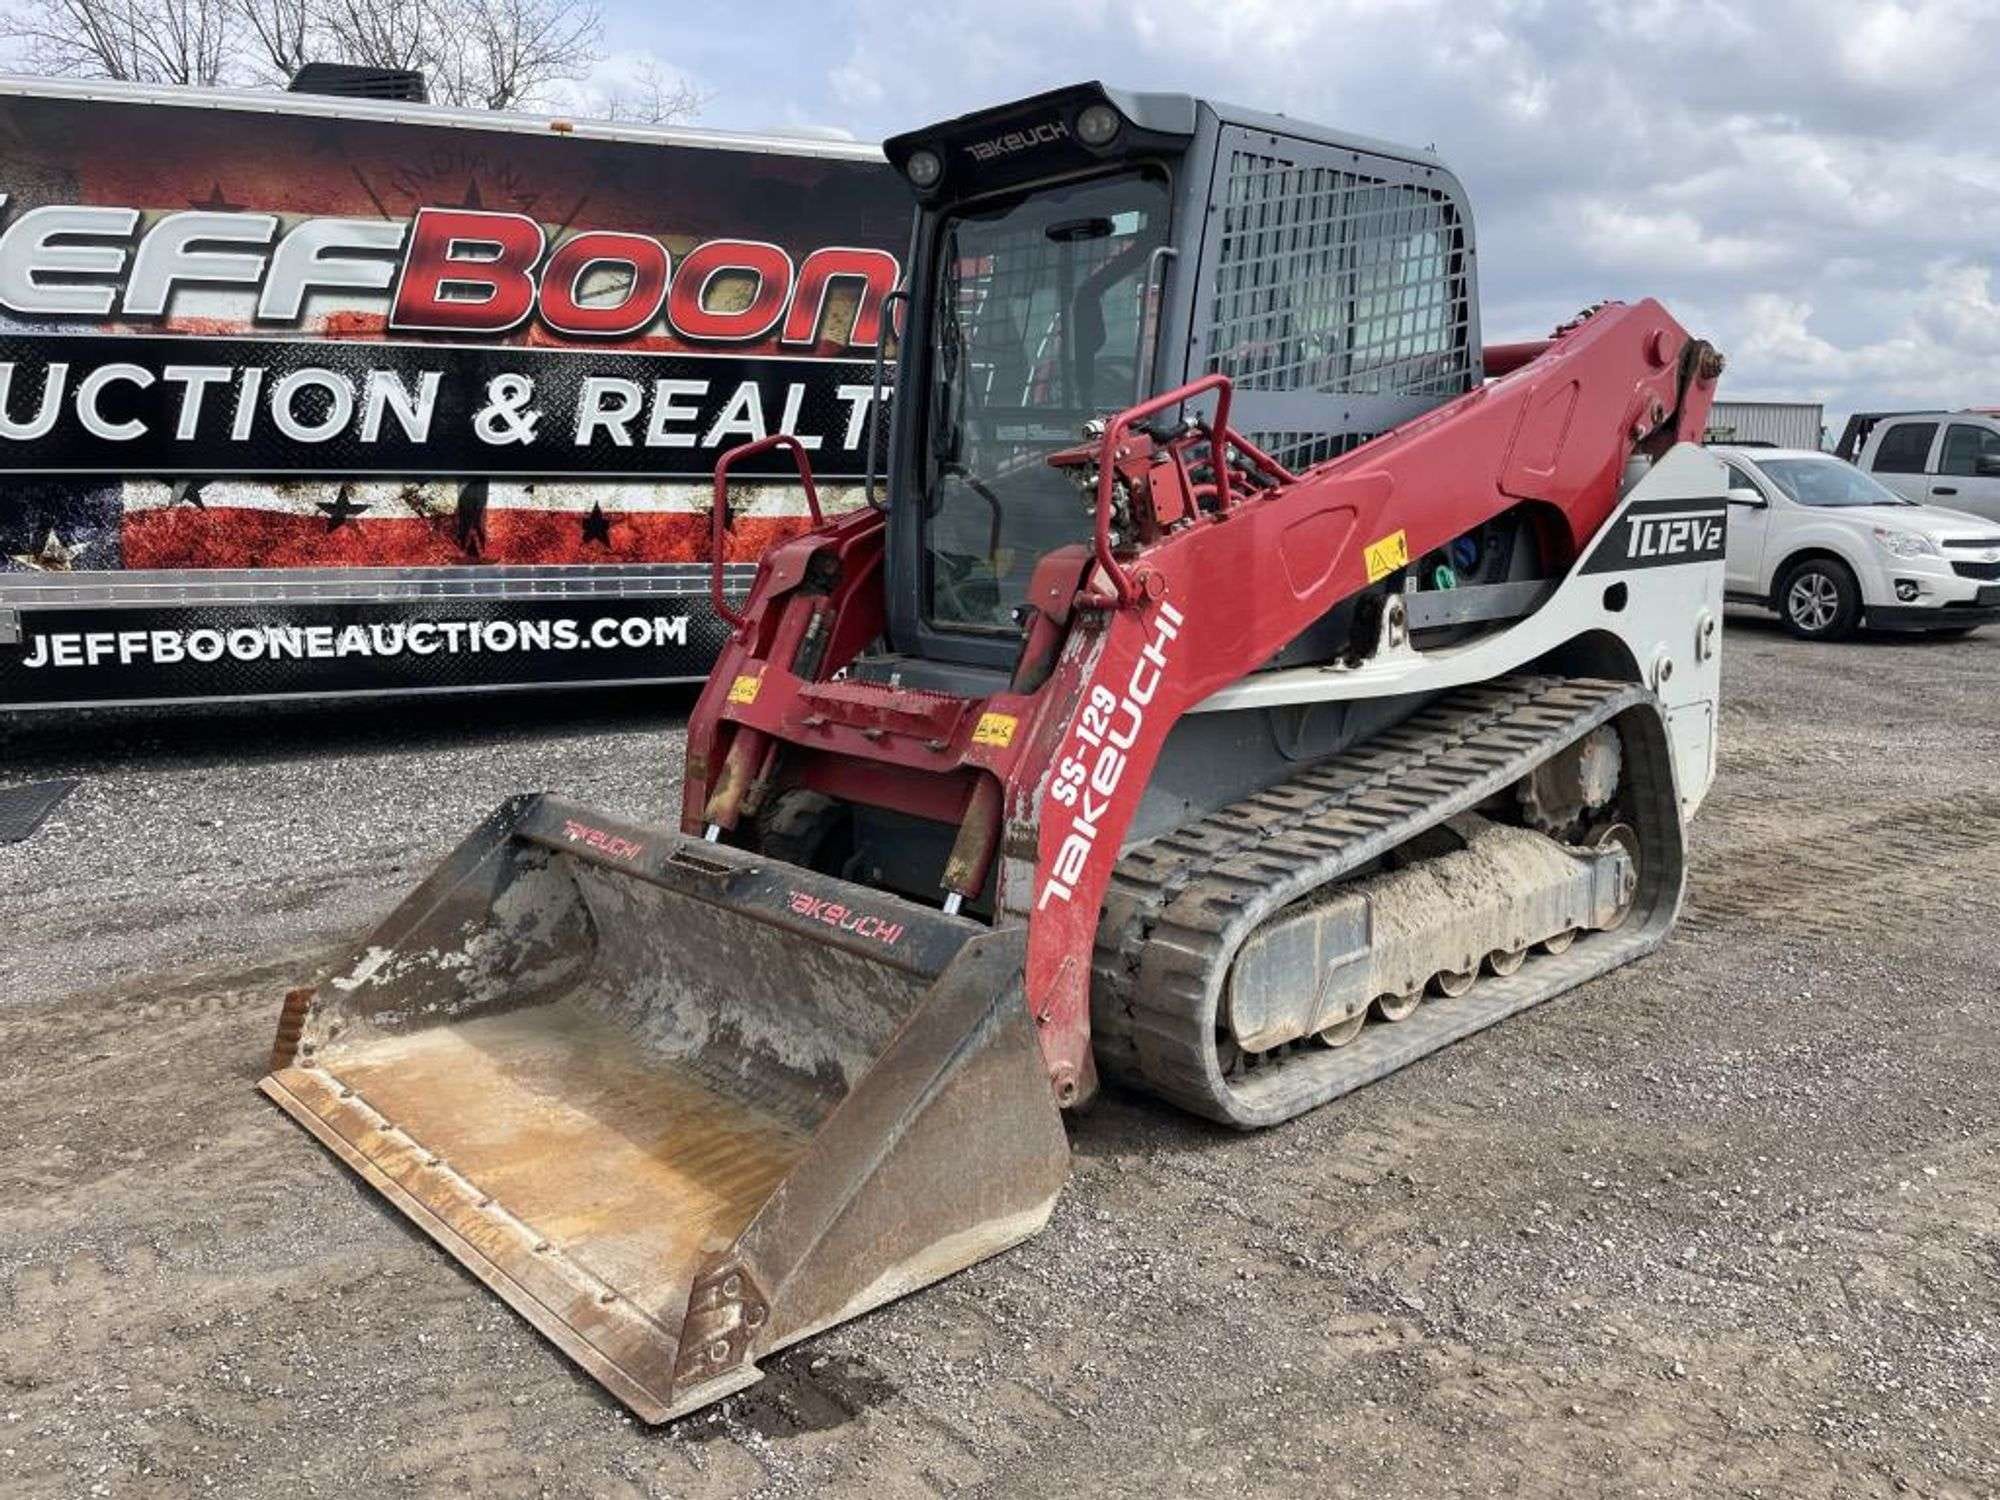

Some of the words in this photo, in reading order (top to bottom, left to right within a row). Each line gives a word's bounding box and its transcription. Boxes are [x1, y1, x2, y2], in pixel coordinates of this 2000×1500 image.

[473, 373, 542, 446] &
[574, 377, 895, 450] REALT
[23, 616, 689, 668] JEFFBOONEAUCTIONS.COM
[1051, 685, 1117, 807] SS-129
